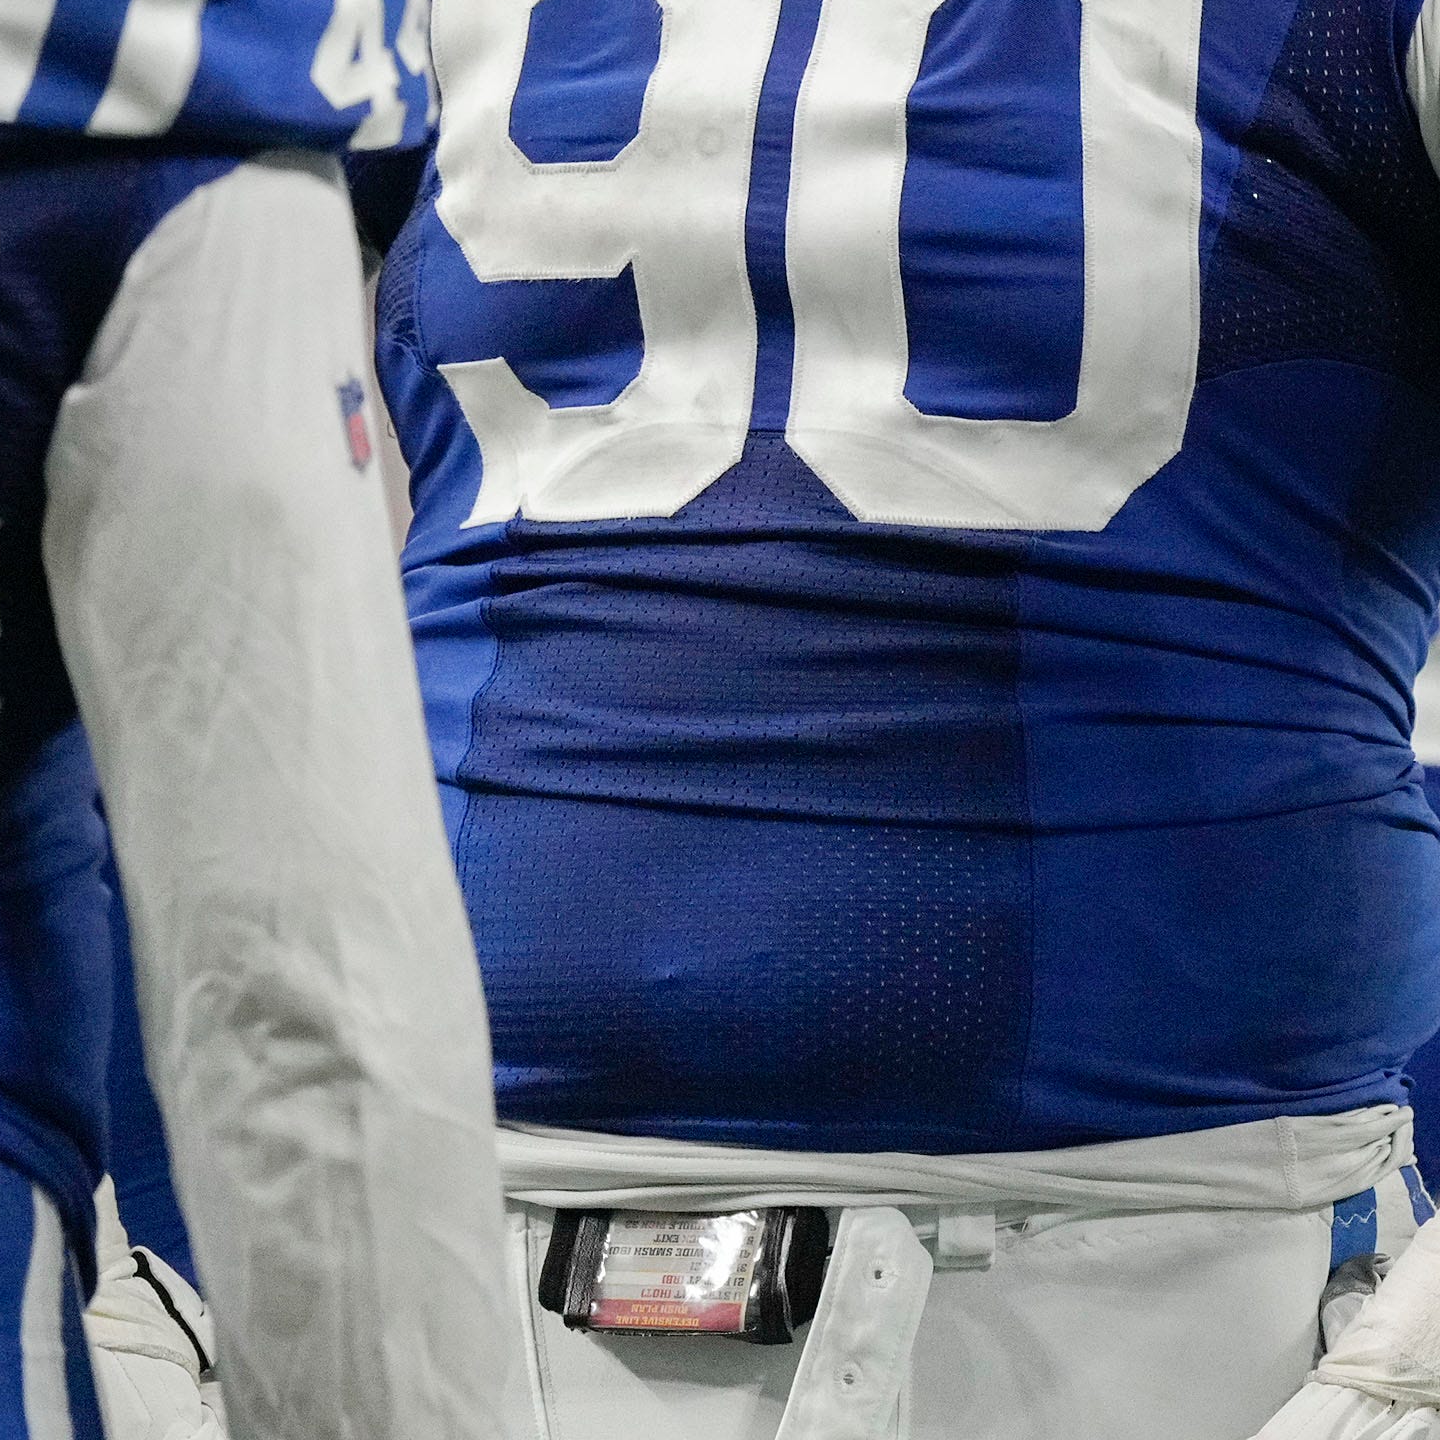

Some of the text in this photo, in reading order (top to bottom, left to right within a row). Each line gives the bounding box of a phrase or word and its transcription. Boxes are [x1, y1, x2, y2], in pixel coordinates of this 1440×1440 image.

[653, 1234, 680, 1244] EXIT
[634, 1247, 673, 1258] SMASH
[631, 1303, 688, 1315] RUSH PLAN
[615, 1314, 700, 1327] DEFENSIVE LINE
